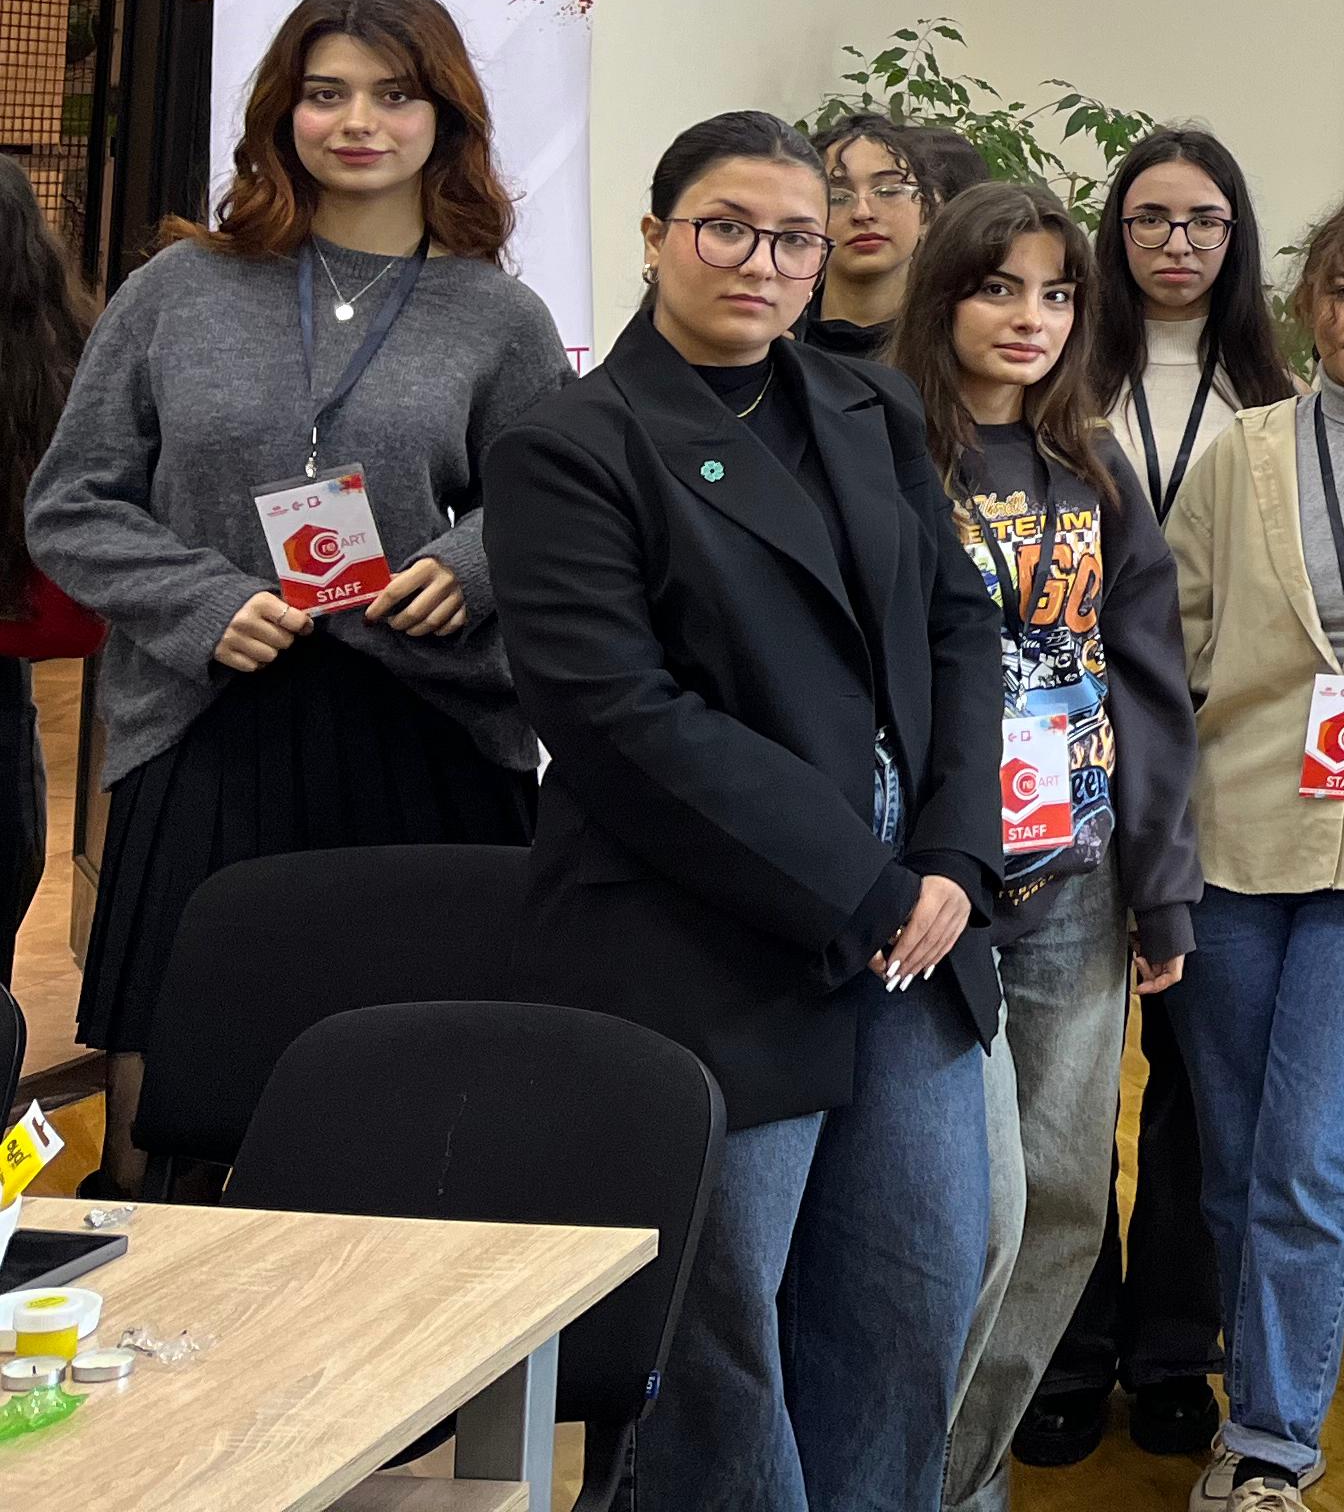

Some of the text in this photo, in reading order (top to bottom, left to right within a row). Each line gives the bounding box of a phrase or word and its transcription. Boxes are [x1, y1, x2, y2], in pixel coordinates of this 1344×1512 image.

[340, 531, 367, 549] ART
[316, 581, 362, 604] STAFF
[1038, 774, 1060, 788] ART
[1008, 823, 1047, 841] STAFF
